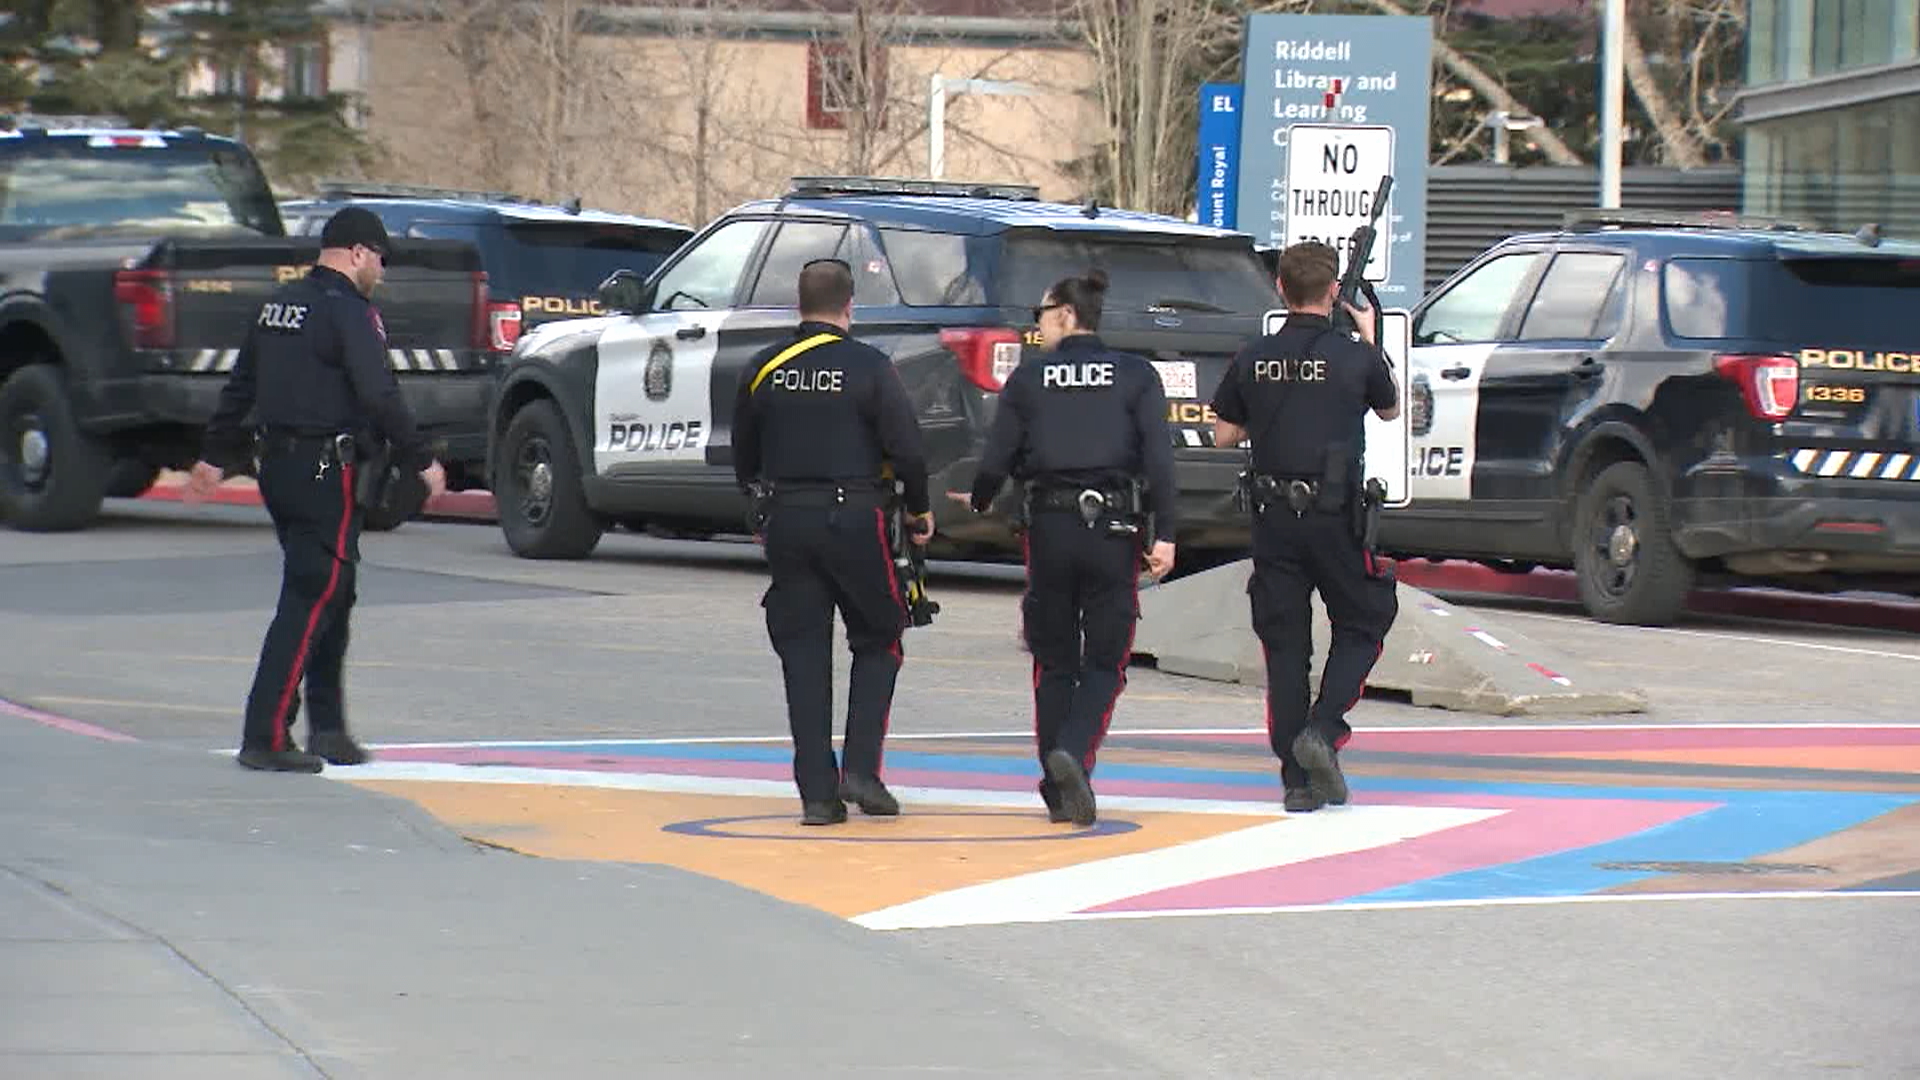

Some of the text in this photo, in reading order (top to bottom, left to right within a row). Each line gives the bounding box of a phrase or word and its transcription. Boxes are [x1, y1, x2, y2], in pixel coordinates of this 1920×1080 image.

[1276, 40, 1351, 60] Riddell
[1357, 71, 1397, 90] and
[1212, 95, 1235, 112] EL
[1273, 98, 1367, 122] Learng
[1210, 146, 1229, 189] Royal
[1322, 143, 1358, 174] NO
[257, 303, 308, 329] POLICE
[771, 368, 843, 391] POLICE
[1043, 362, 1115, 387] POLICE
[1255, 359, 1327, 382] POLICE
[1168, 402, 1217, 423] ICE
[608, 421, 702, 451] POLICE
